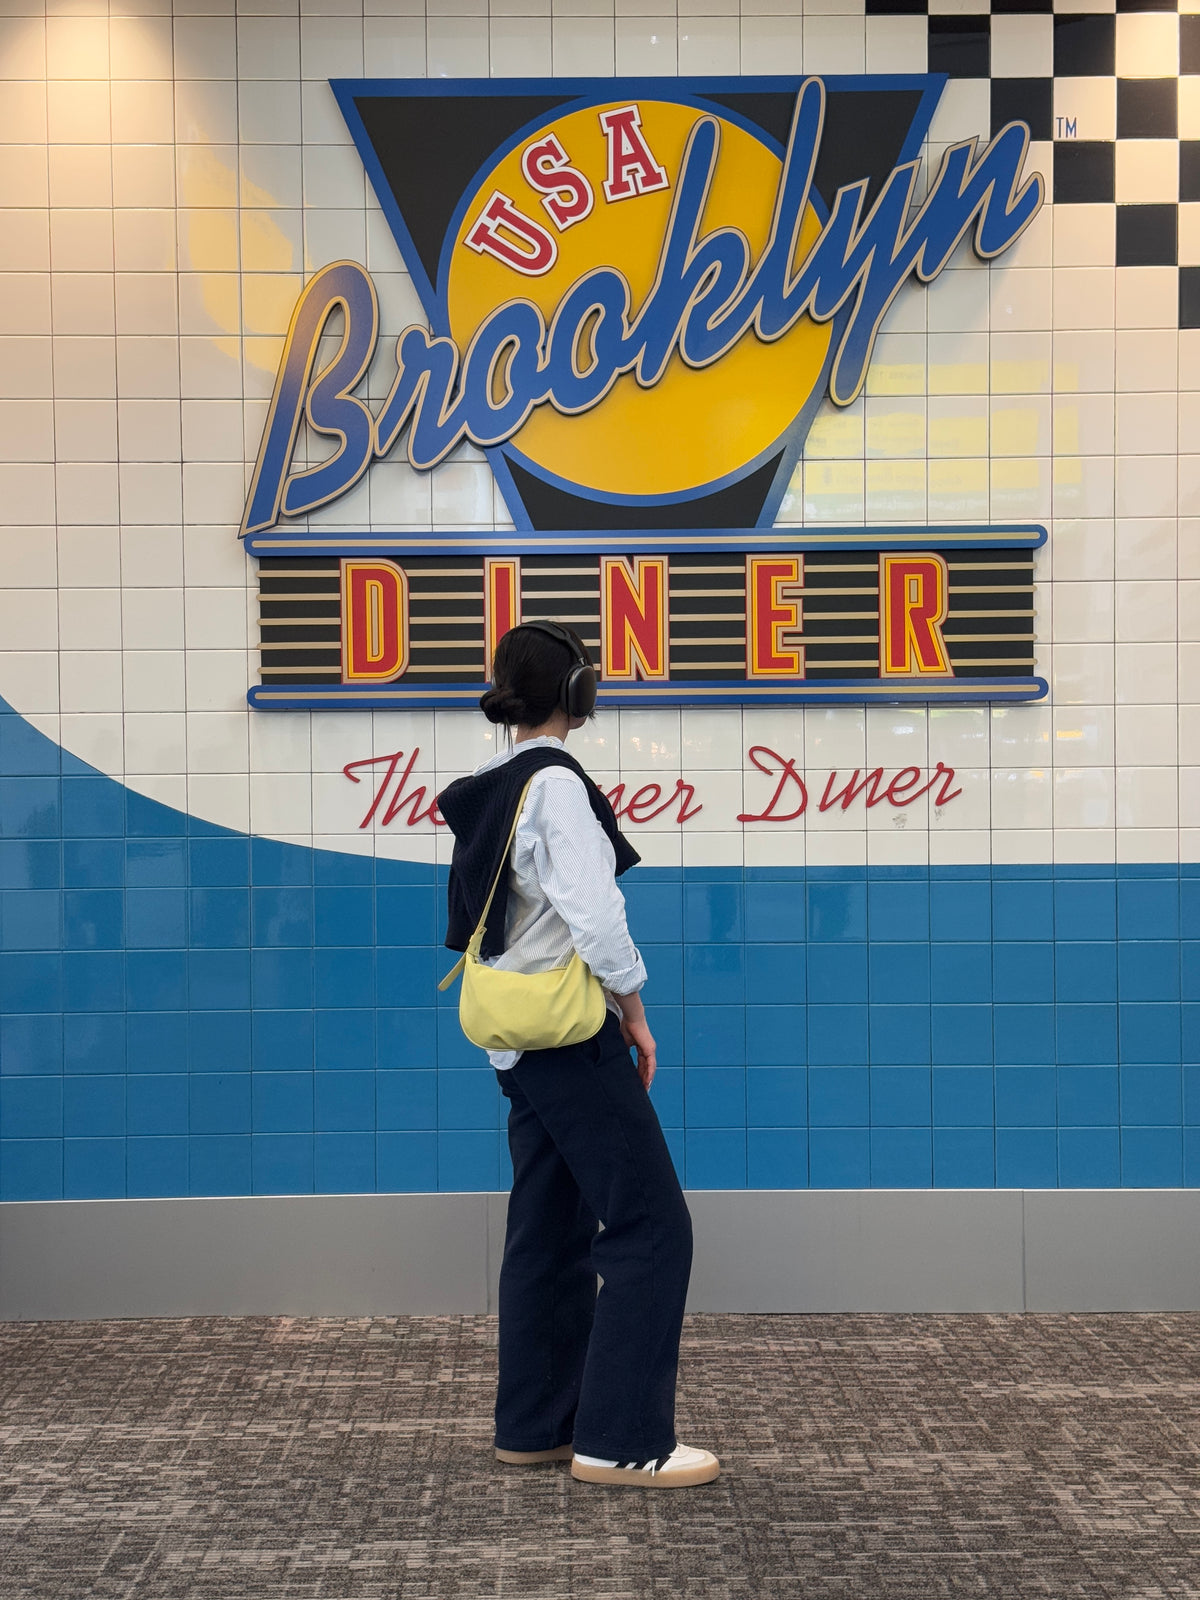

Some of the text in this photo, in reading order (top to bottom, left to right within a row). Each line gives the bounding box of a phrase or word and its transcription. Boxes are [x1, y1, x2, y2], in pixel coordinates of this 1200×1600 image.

[463, 104, 670, 278] USA
[1056, 117, 1077, 138] TM
[239, 75, 1046, 537] Brooklyn
[338, 553, 955, 685] DINER
[737, 745, 962, 822] Diner
